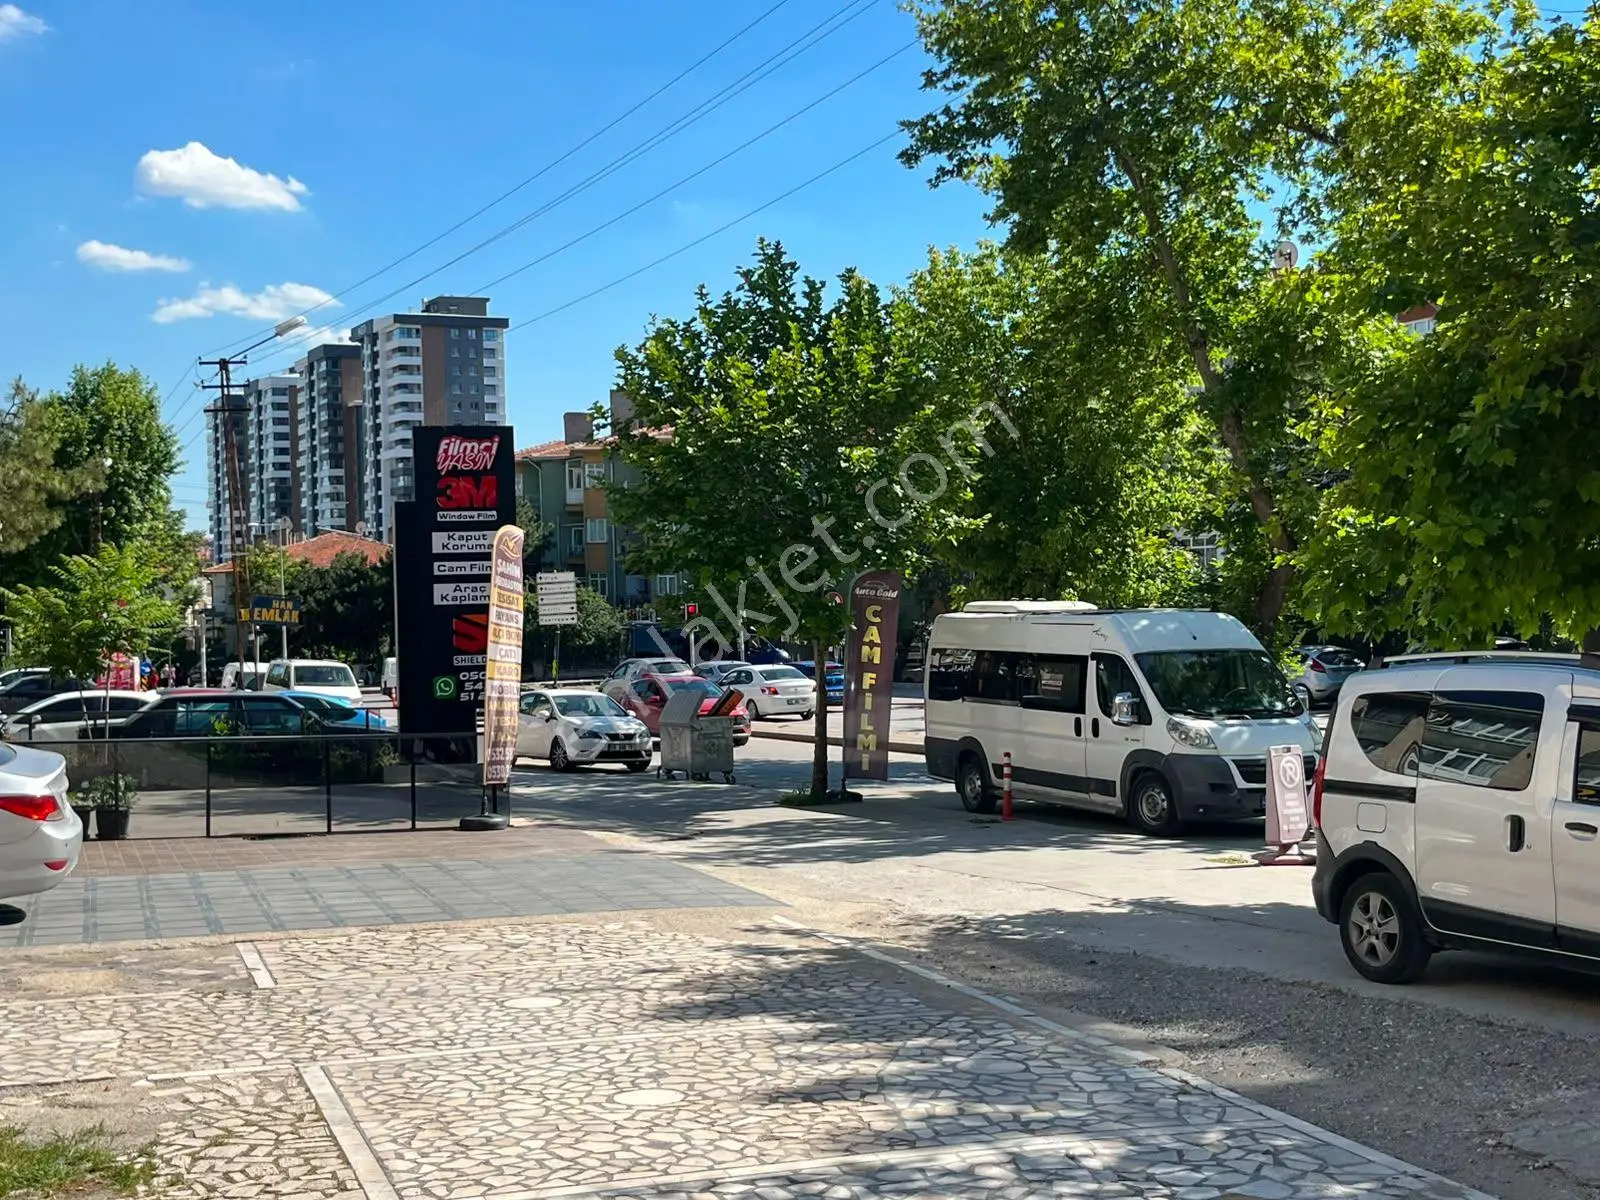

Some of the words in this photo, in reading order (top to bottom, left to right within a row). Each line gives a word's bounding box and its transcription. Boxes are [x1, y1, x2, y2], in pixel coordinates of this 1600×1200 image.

[436, 476, 498, 508] 3M
[438, 513, 475, 521] Window
[477, 512, 496, 520] Film
[447, 533, 488, 543] Kaput
[441, 543, 493, 551] Koruma
[437, 564, 467, 573] Cam
[453, 585, 487, 594] Araç
[440, 593, 490, 604] Kaplam
[272, 600, 293, 609] HAN
[254, 608, 300, 623] EMLAK
[861, 604, 882, 664] CAM
